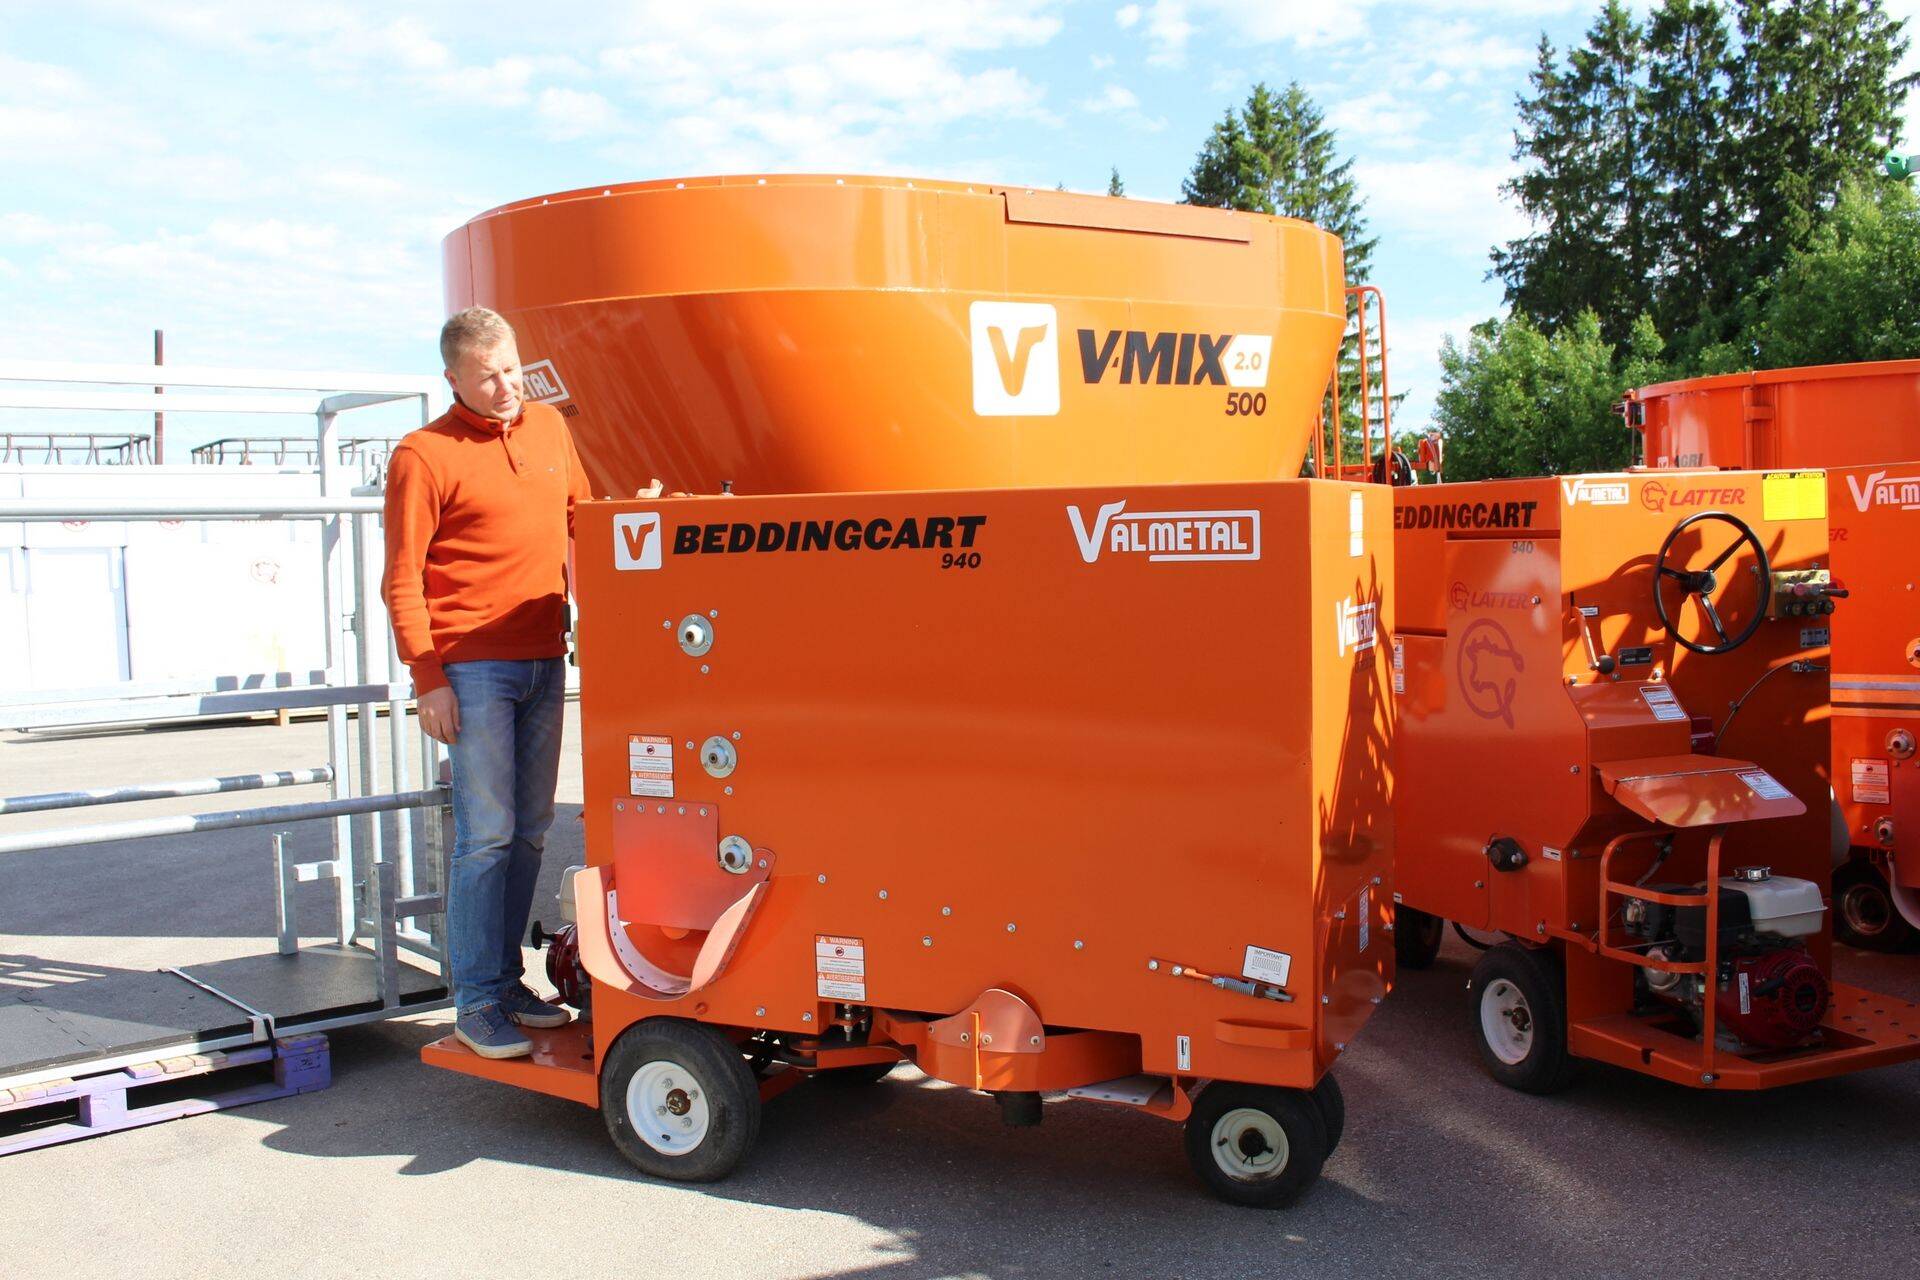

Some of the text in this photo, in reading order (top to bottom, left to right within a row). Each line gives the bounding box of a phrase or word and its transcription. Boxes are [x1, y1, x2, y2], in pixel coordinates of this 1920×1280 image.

[1234, 351, 1262, 370] 2.0
[1225, 392, 1267, 416] 500
[1562, 479, 1627, 506] VALMETAL
[1669, 488, 1746, 507] LATTER
[673, 515, 987, 555] BEDDINGCART
[1066, 499, 1256, 563] VALMETAL
[1511, 540, 1533, 554] 940
[941, 552, 981, 569] 940
[1471, 591, 1529, 609] LATTER
[641, 736, 668, 744] WARNING
[830, 937, 859, 946] WARNING
